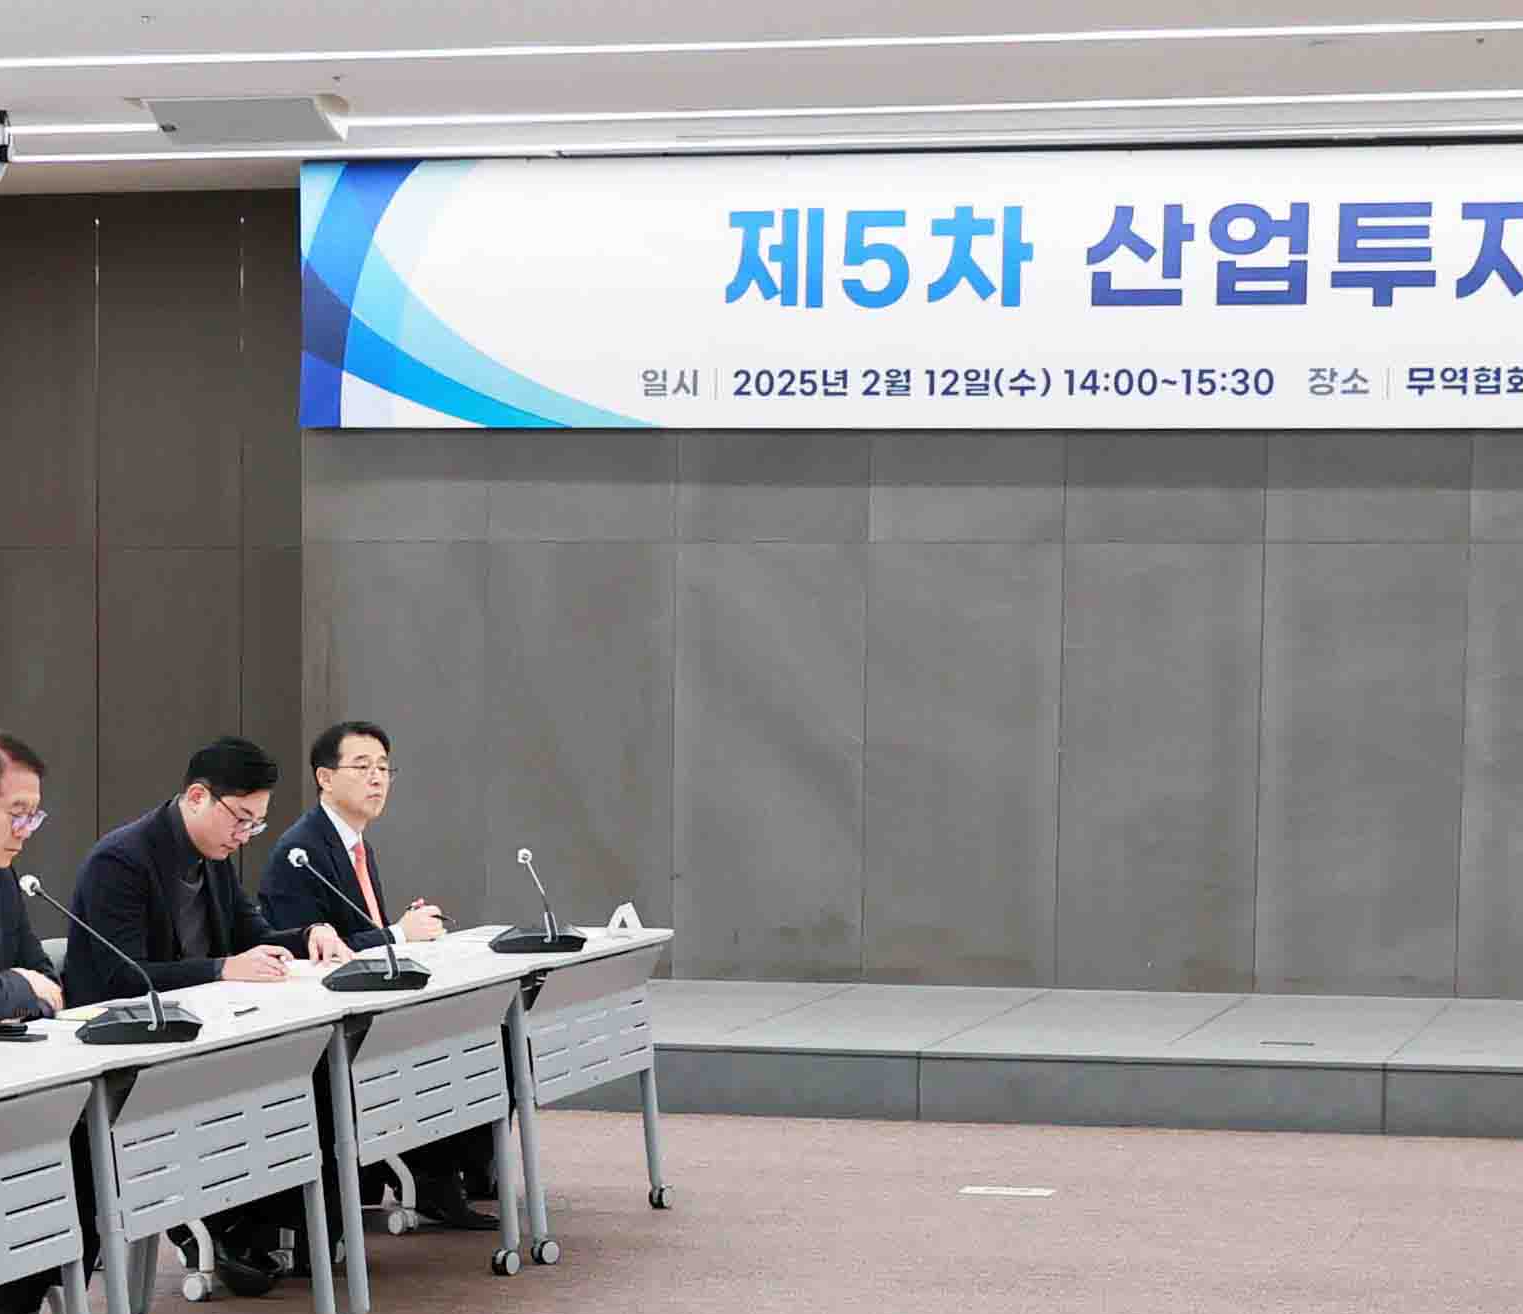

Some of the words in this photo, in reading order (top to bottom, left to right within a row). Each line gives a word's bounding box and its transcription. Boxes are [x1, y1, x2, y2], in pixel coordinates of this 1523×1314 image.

[724, 205, 1034, 310] 제5차
[641, 368, 699, 398] 일시
[732, 368, 849, 398] 2025년
[859, 367, 912, 398] 2월
[924, 367, 1052, 399] 12일(수)
[1063, 367, 1275, 397] 14:00~15:30
[1307, 367, 1370, 397] 장소
